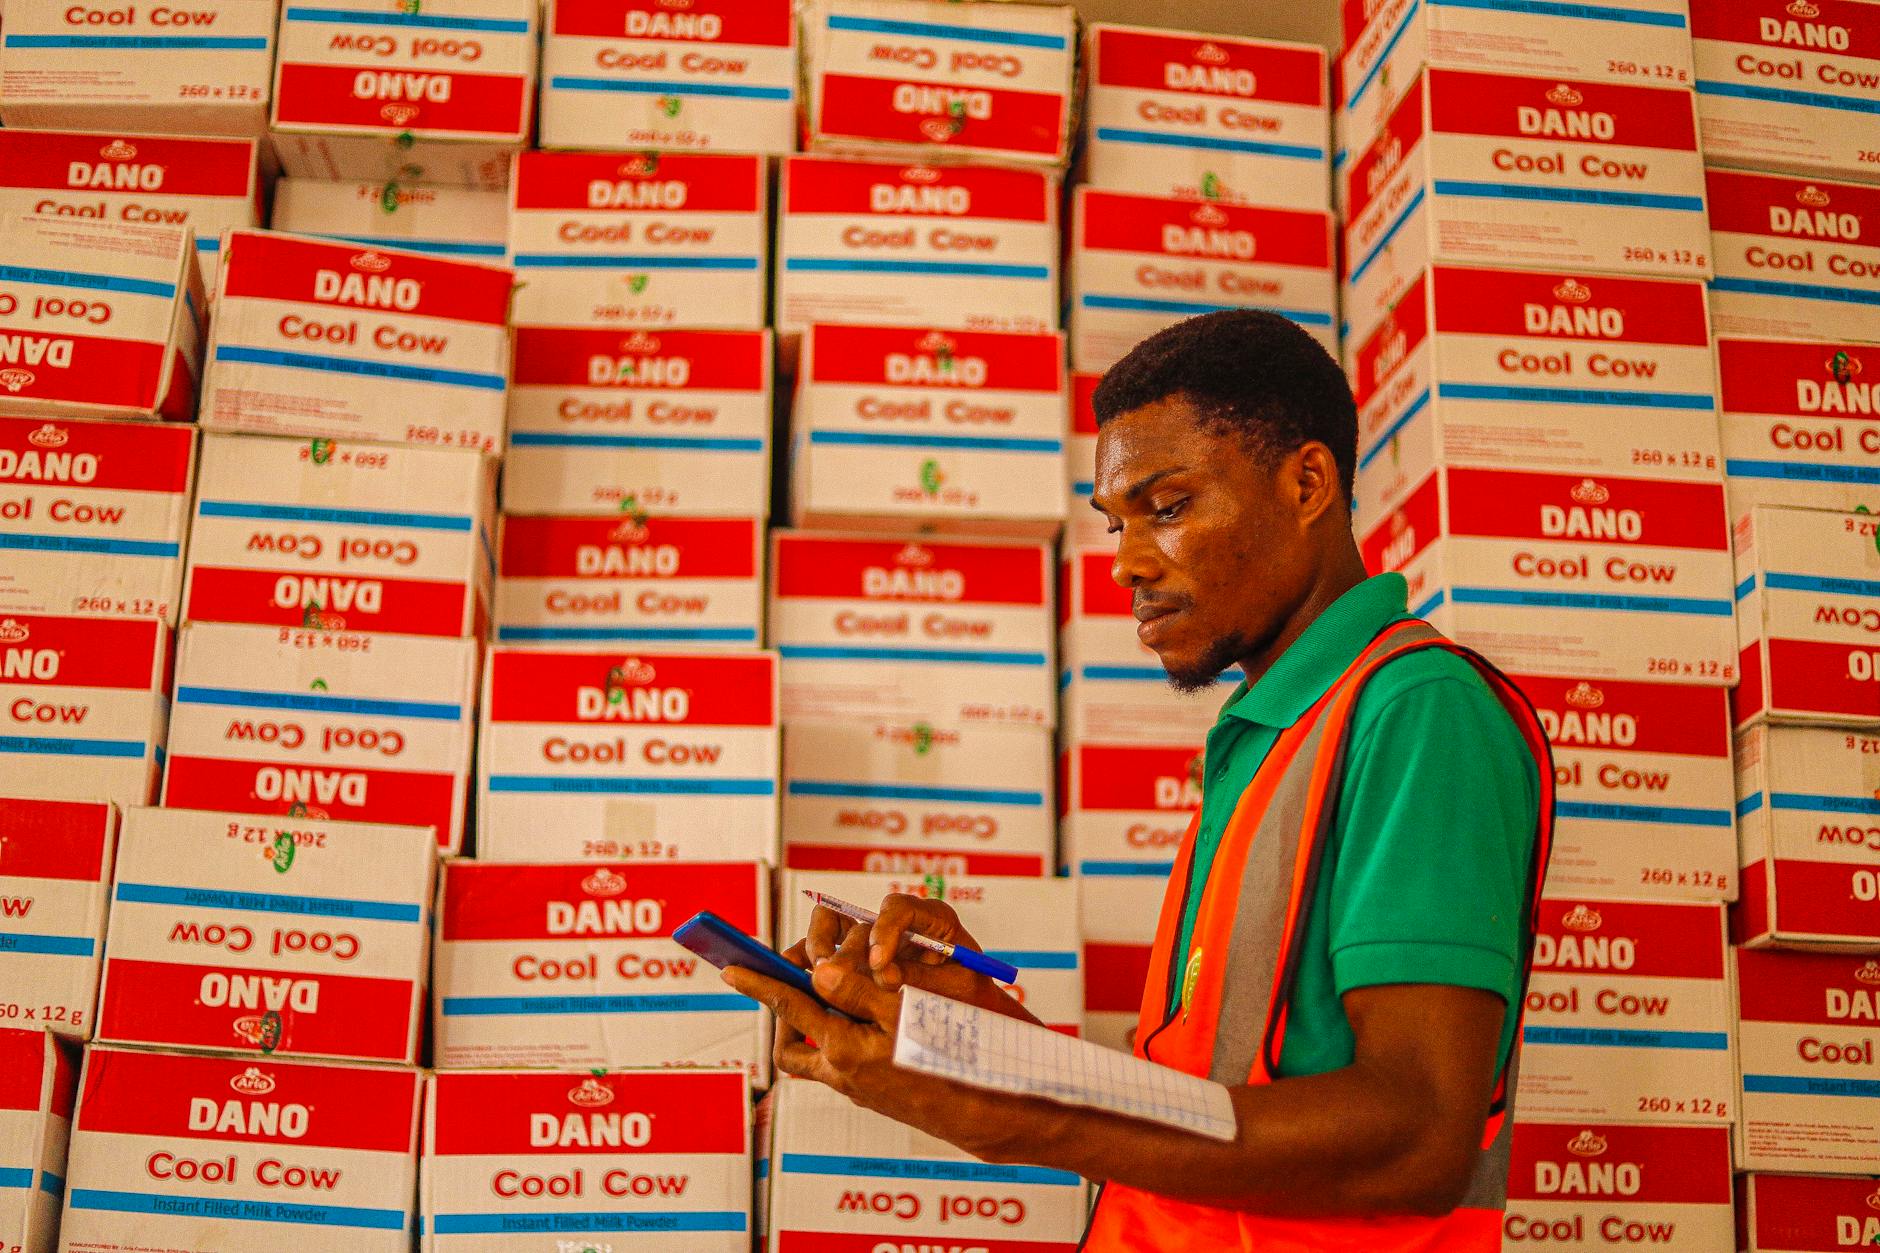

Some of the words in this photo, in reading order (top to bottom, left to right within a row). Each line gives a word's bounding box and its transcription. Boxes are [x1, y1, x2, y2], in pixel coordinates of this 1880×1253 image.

[65, 6, 135, 25] Cool
[150, 7, 216, 26] Cow
[330, 35, 397, 57] Cow
[1760, 18, 1849, 50] DANO
[411, 39, 483, 62] Cool
[1736, 55, 1803, 80] Cool
[1816, 60, 1880, 89] Cow
[354, 72, 451, 102] DANO
[1519, 107, 1614, 139] DANO
[69, 162, 163, 190] DANO
[1492, 149, 1564, 174] Cool
[1580, 155, 1647, 180] Cow
[35, 200, 106, 219] Cool
[121, 204, 188, 225] Cow
[1770, 207, 1860, 239] DANO
[1745, 247, 1813, 271] Cool
[315, 270, 420, 309] DANO
[34, 297, 111, 324] Cool
[1525, 304, 1623, 337] DANO
[279, 315, 357, 345] Cool
[373, 326, 447, 354] Cow
[0, 335, 73, 368] DAN
[1497, 349, 1572, 374] Cool
[1587, 354, 1656, 378] Cow
[1770, 424, 1843, 451] Cool
[0, 450, 97, 482] DANO
[1, 498, 32, 519] ol
[49, 500, 124, 524] Cow
[1541, 506, 1641, 540] DANO
[247, 533, 323, 559] Cow
[339, 539, 419, 565] Cool
[1513, 553, 1588, 579] Cool
[1605, 558, 1675, 583] Cow
[275, 577, 382, 612] DANO
[1815, 607, 1880, 632] Cow
[0, 649, 59, 679] NO
[11, 698, 87, 723] Cow
[578, 688, 688, 720] DANO
[226, 721, 305, 749] Cow
[322, 727, 405, 755] Cool
[1537, 709, 1636, 745] DANO
[543, 738, 625, 763] Cool
[642, 739, 720, 765] Cow
[256, 768, 367, 805] DANO
[1555, 763, 1581, 785] ol
[1598, 764, 1669, 791] Cow
[1818, 825, 1880, 851] Cow
[1642, 869, 1672, 884] 260
[1678, 874, 1686, 884] x
[1694, 871, 1712, 886] 12
[1717, 876, 1727, 890] g
[548, 900, 661, 933] DANO
[170, 923, 252, 952] Cow
[272, 930, 359, 960] Cool
[1533, 935, 1634, 969] DANO
[513, 955, 597, 981] Cool
[616, 954, 697, 979] Cow
[200, 973, 319, 1013] DANO
[1526, 989, 1578, 1013] ool
[1595, 989, 1668, 1016] Cow
[1826, 989, 1880, 1019] DA
[25, 1008, 35, 1019] x
[43, 1006, 66, 1021] 12
[71, 1011, 83, 1026] g
[1798, 1038, 1872, 1064] Cool
[189, 1098, 308, 1137] DANO
[1638, 1097, 1670, 1112] 260
[1676, 1102, 1684, 1112] x
[1692, 1099, 1711, 1113] 12
[1716, 1103, 1726, 1117] g
[531, 1113, 650, 1146] DANO
[148, 1153, 235, 1182] Cool
[256, 1160, 340, 1189] Cow
[493, 1170, 582, 1197] Cool
[603, 1170, 687, 1196] Cow
[1536, 1162, 1640, 1195] DANO
[153, 1199, 199, 1213] Instant
[205, 1201, 239, 1216] Filled
[244, 1204, 271, 1218] Milk
[277, 1206, 327, 1222] Powder
[838, 1191, 921, 1220] Cow
[940, 1196, 1026, 1225] Cool
[502, 1217, 549, 1230] Instant
[554, 1217, 589, 1229] Filled
[594, 1216, 622, 1228] Milk
[627, 1216, 678, 1228] Powder
[1503, 1215, 1583, 1242] Cool
[1599, 1216, 1674, 1243] Cow
[1837, 1216, 1880, 1246] DA
